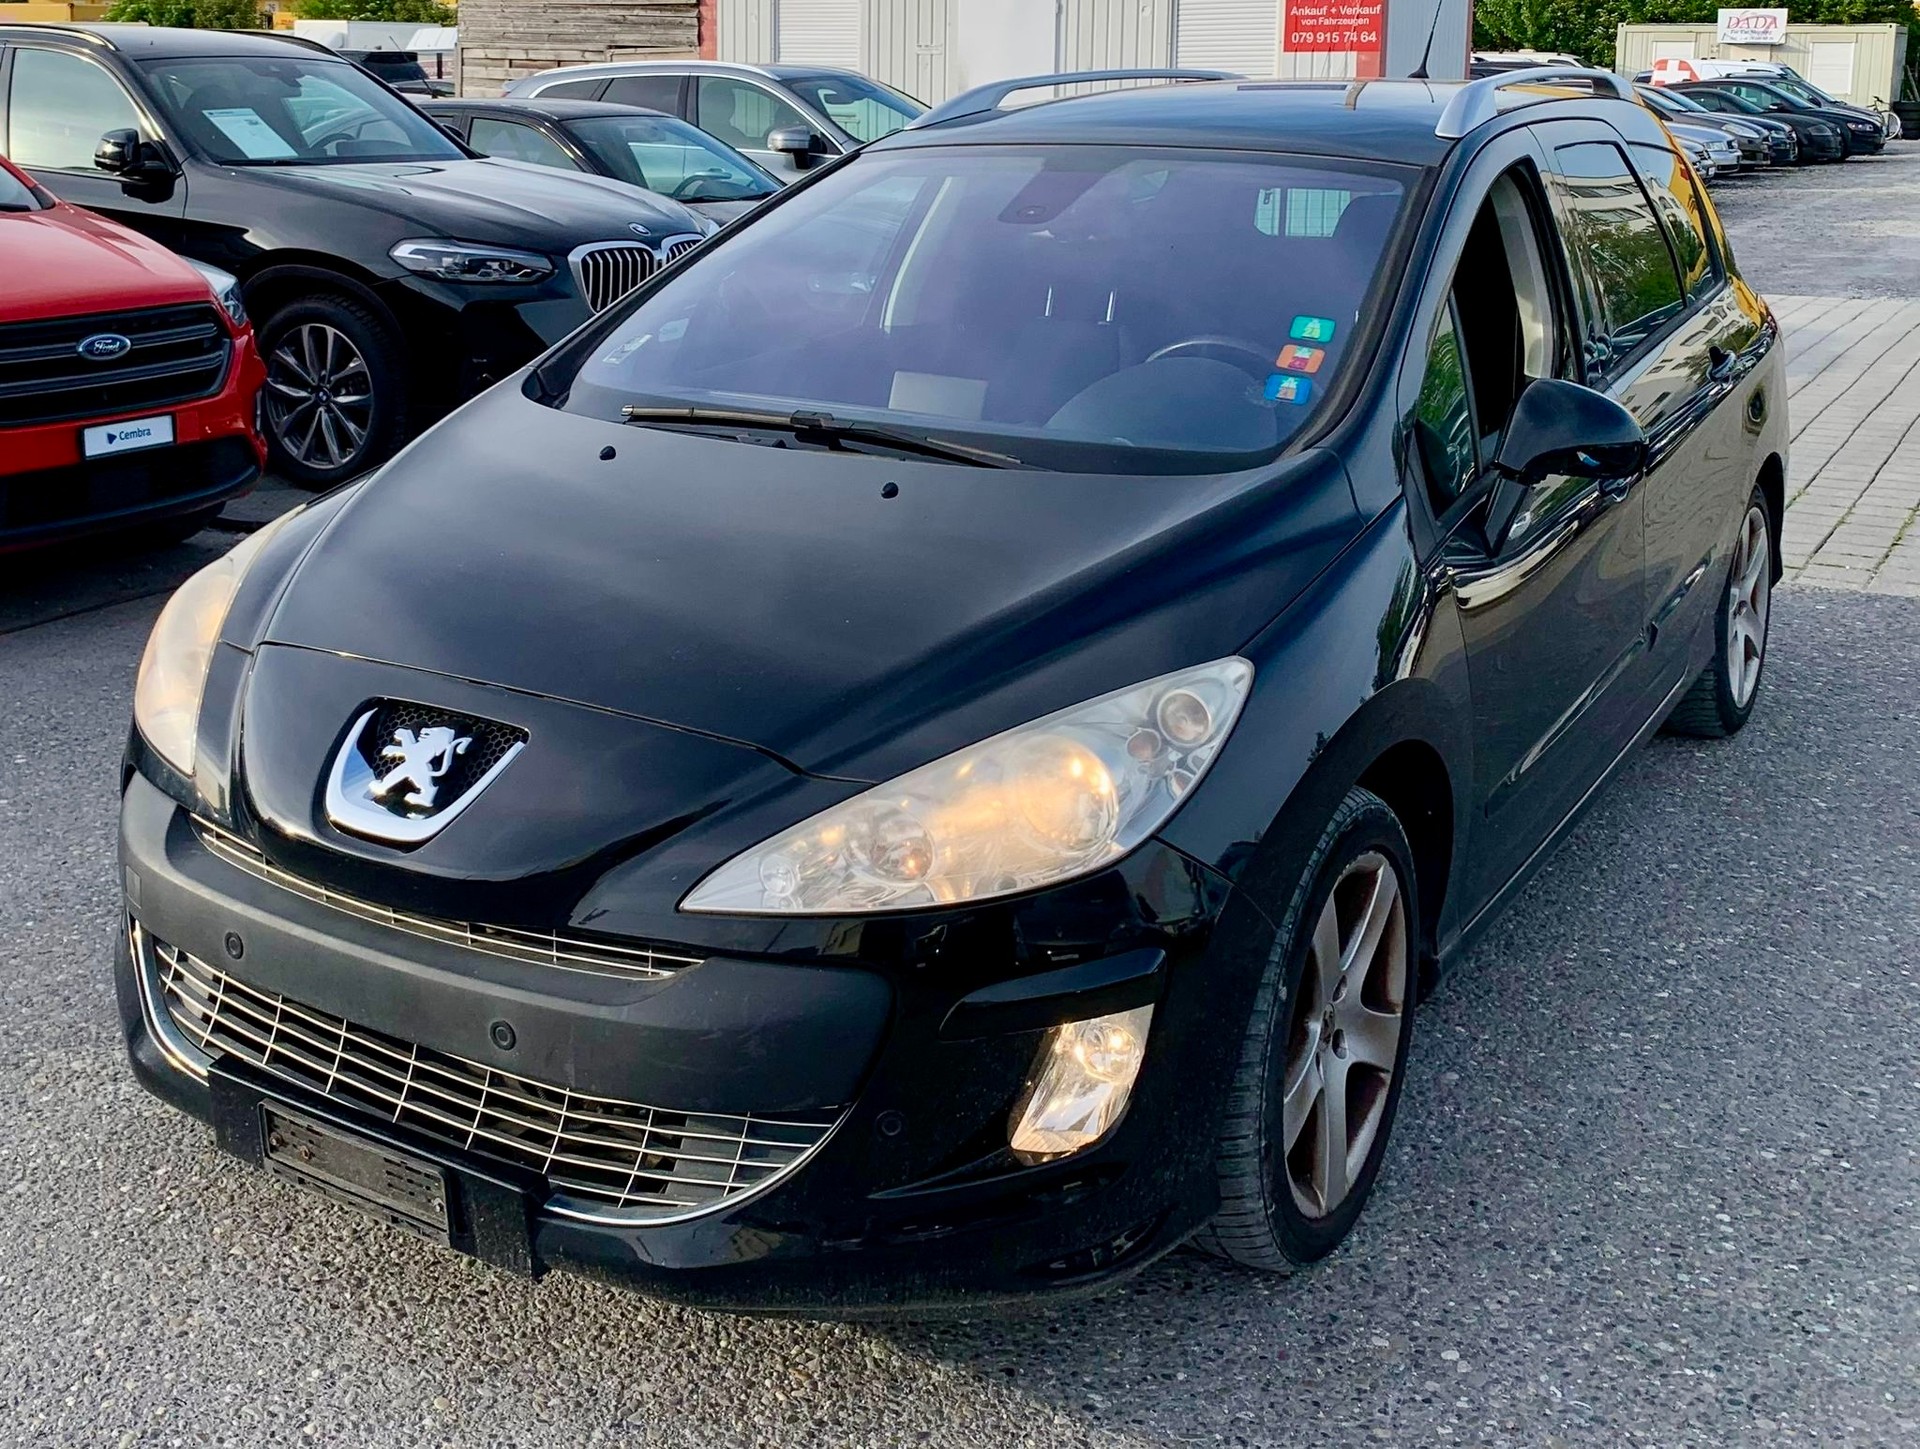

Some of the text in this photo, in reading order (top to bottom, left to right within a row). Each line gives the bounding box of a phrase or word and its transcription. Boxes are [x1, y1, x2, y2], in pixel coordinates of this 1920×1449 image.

[1290, 6, 1328, 16] Ankauf
[1339, 4, 1382, 15] Verkauf
[1301, 17, 1370, 26] von Fahrzeugen
[1726, 15, 1778, 29] DADA
[1291, 31, 1377, 43] 079 915 74 64
[93, 339, 121, 354] Ford
[118, 427, 152, 441] Cembra
